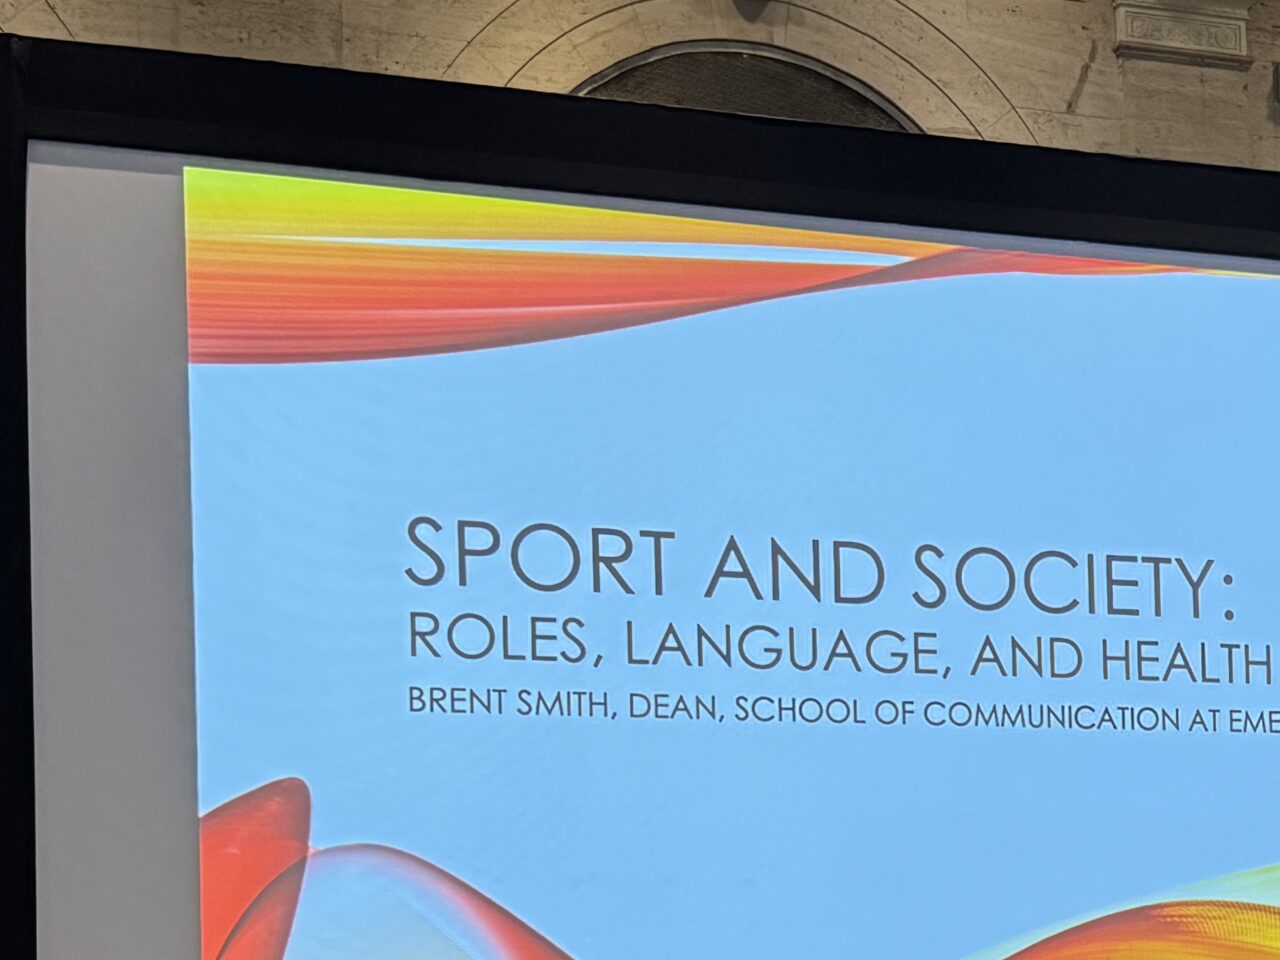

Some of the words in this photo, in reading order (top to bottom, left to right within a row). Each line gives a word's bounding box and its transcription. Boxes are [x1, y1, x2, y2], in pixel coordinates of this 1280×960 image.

[404, 516, 676, 596] SPORT
[704, 534, 885, 605] AND
[911, 543, 1233, 621] SOCIETY:
[409, 611, 604, 668] ROLES,
[626, 620, 951, 680] LANGUAGE,
[970, 634, 1082, 679] AND
[1102, 638, 1272, 685] HEALTH
[408, 686, 508, 715] BRENT
[516, 689, 617, 721] SMITH,
[629, 692, 725, 723] DEAN,
[734, 695, 867, 725] SCHOOL
[874, 699, 915, 726] OF
[923, 700, 1180, 732] COMMUNICATION
[1188, 708, 1221, 734] AT
